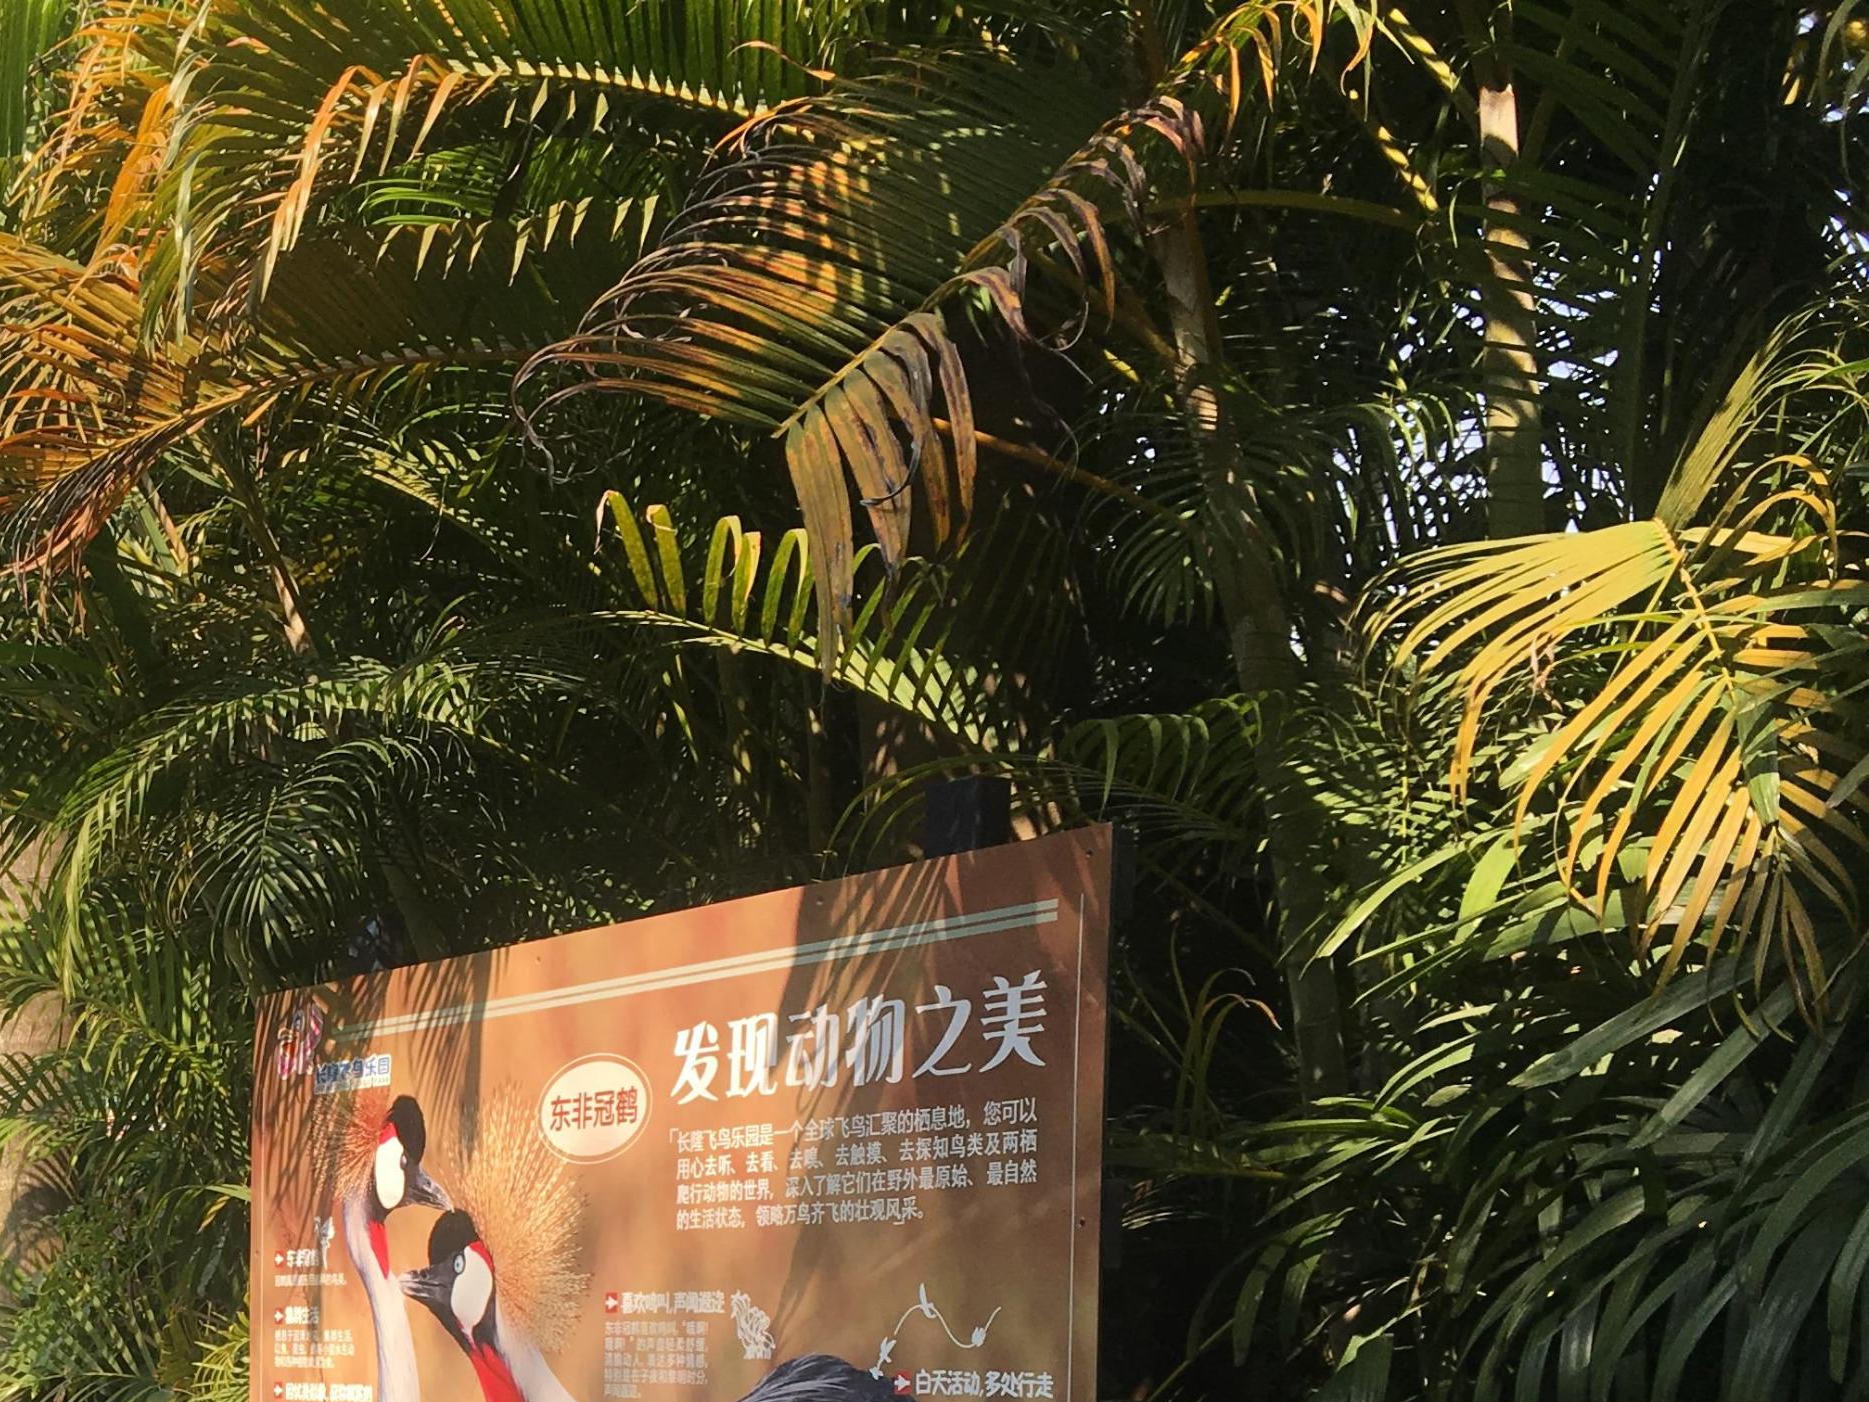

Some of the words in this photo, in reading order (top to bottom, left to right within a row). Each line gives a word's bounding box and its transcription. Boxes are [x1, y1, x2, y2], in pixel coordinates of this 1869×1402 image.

[670, 969, 1049, 1105] 发现动物之美
[550, 1086, 638, 1132] 东非冠鹤
